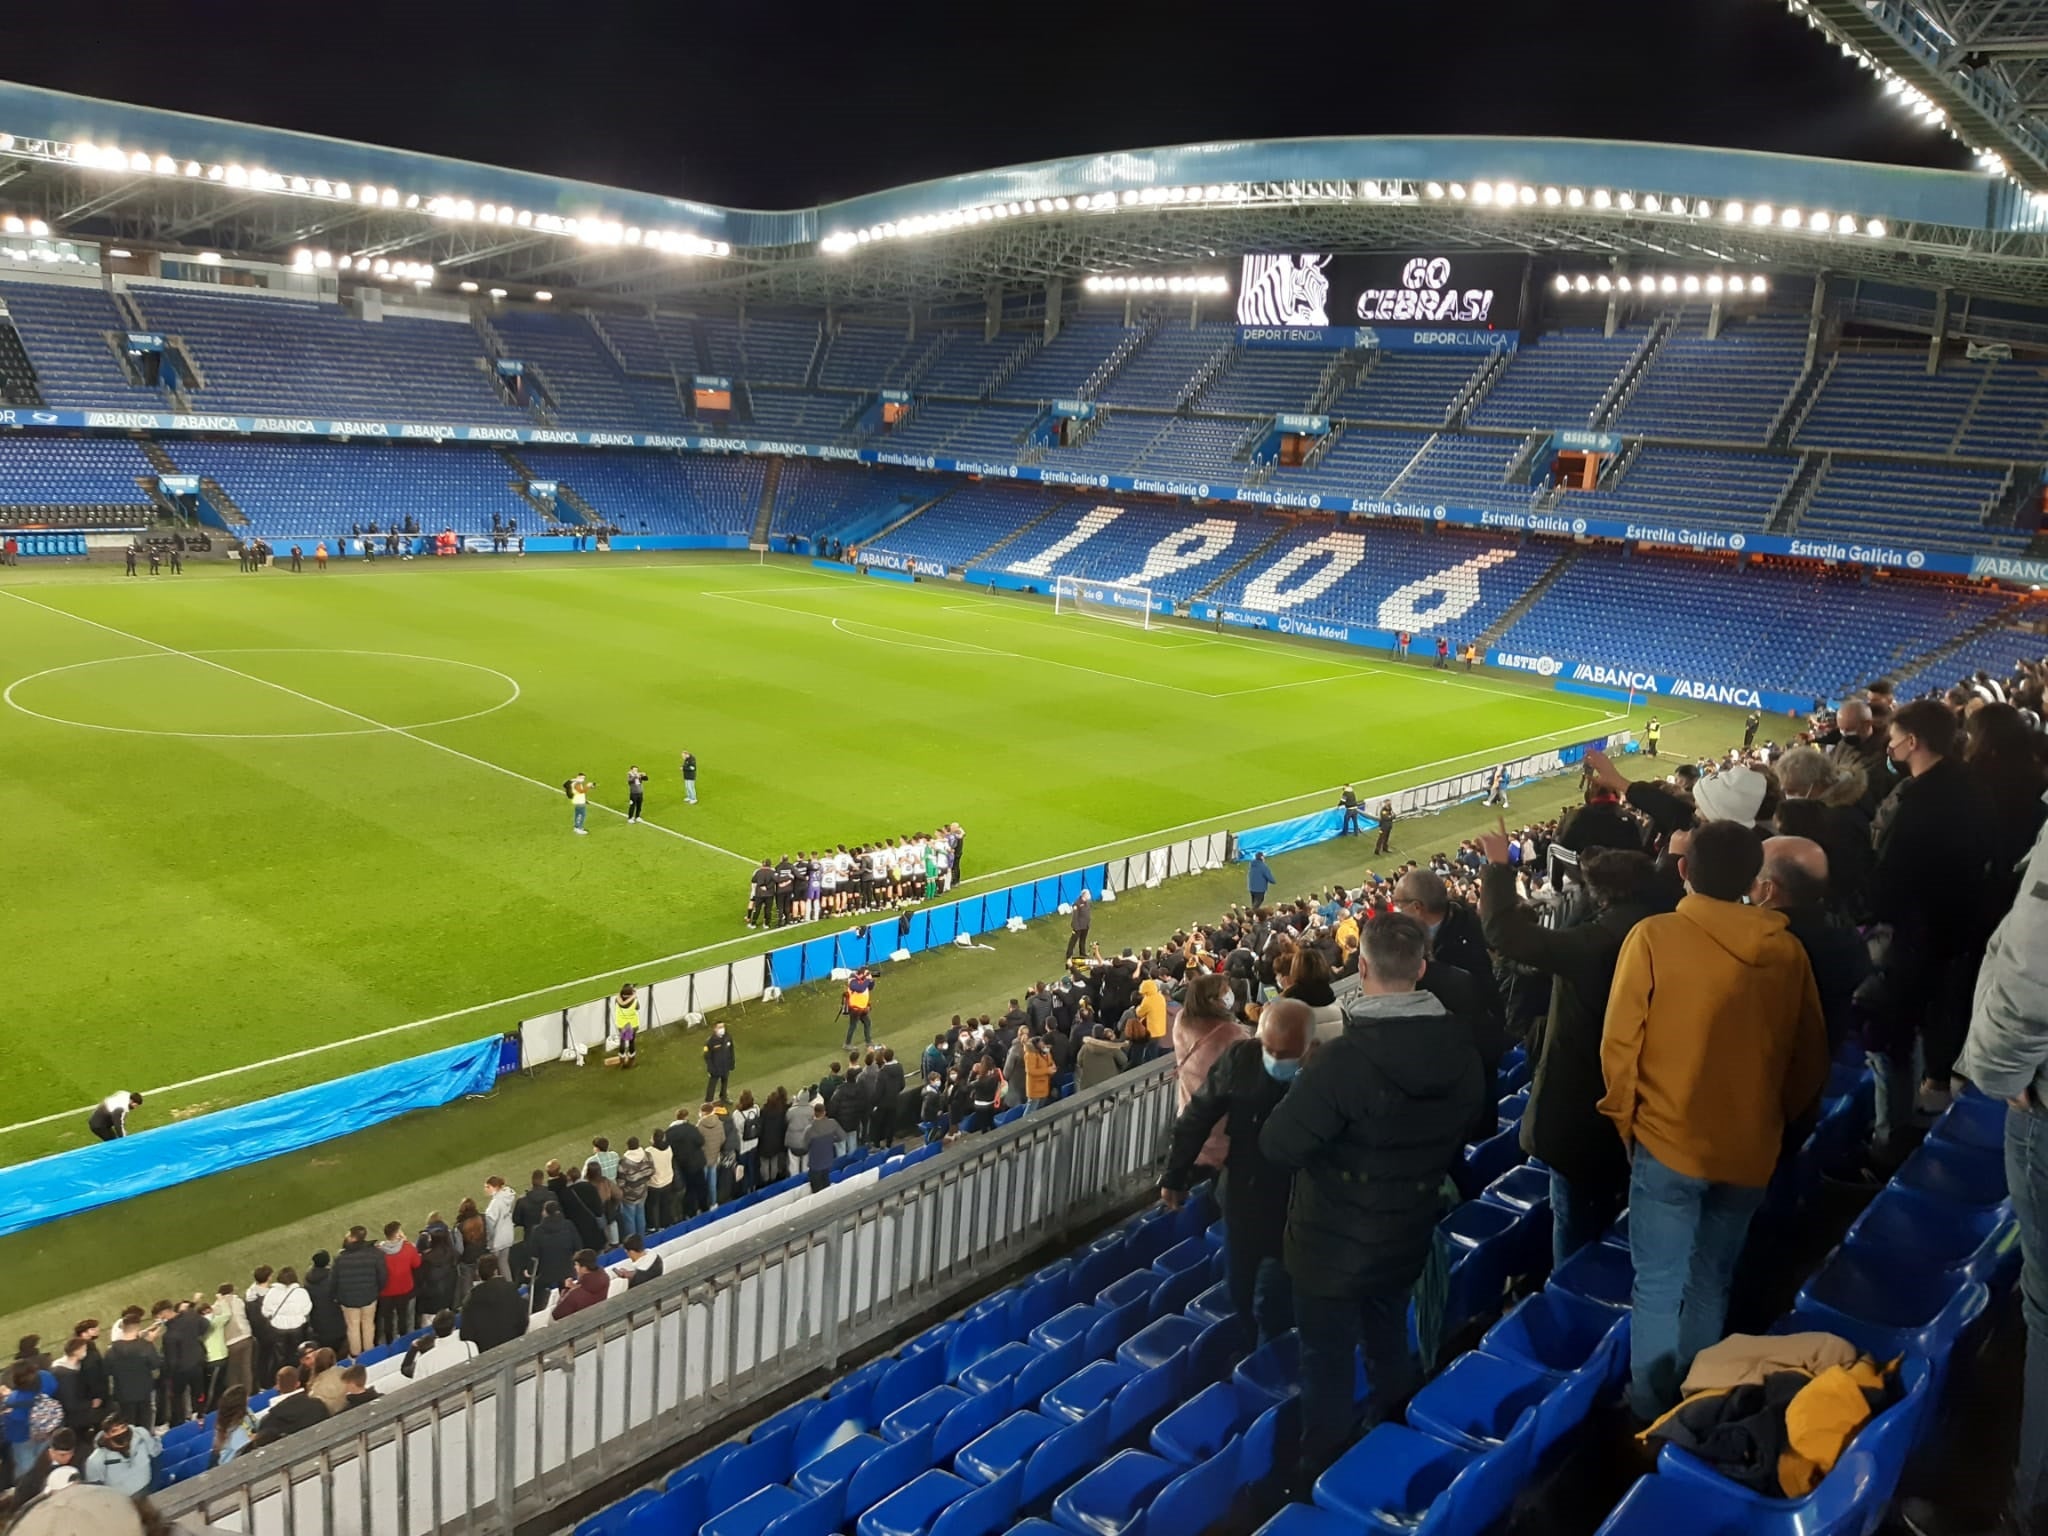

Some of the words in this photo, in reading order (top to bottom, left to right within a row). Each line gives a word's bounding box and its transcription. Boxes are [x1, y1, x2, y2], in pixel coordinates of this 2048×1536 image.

[1402, 257, 1450, 289] GO
[1357, 289, 1494, 321] CEBRAS!
[1243, 329, 1323, 342] DEPORTIENDA
[955, 460, 982, 474] Estrella
[982, 464, 1008, 477] Galicia
[1040, 469, 1069, 483] Estrella
[1070, 472, 1098, 487] Galicia
[1133, 479, 1165, 493] Estrella
[1166, 482, 1197, 497] Galicia
[1236, 488, 1272, 503] Estrella
[1273, 492, 1307, 507] Galicia
[1351, 499, 1391, 515] Estrella
[1392, 504, 1431, 519] Galicia
[1480, 511, 1525, 528] Estrella
[1527, 515, 1569, 532] Galicia
[1625, 524, 1676, 543] Estrella
[1678, 529, 1726, 548] Galicia
[1789, 540, 1847, 560] Estrella
[1848, 545, 1903, 566] Galicia
[1206, 609, 1268, 627] DEORCLÍNICA
[1295, 621, 1317, 637] Vida
[1319, 625, 1348, 641] Móvil
